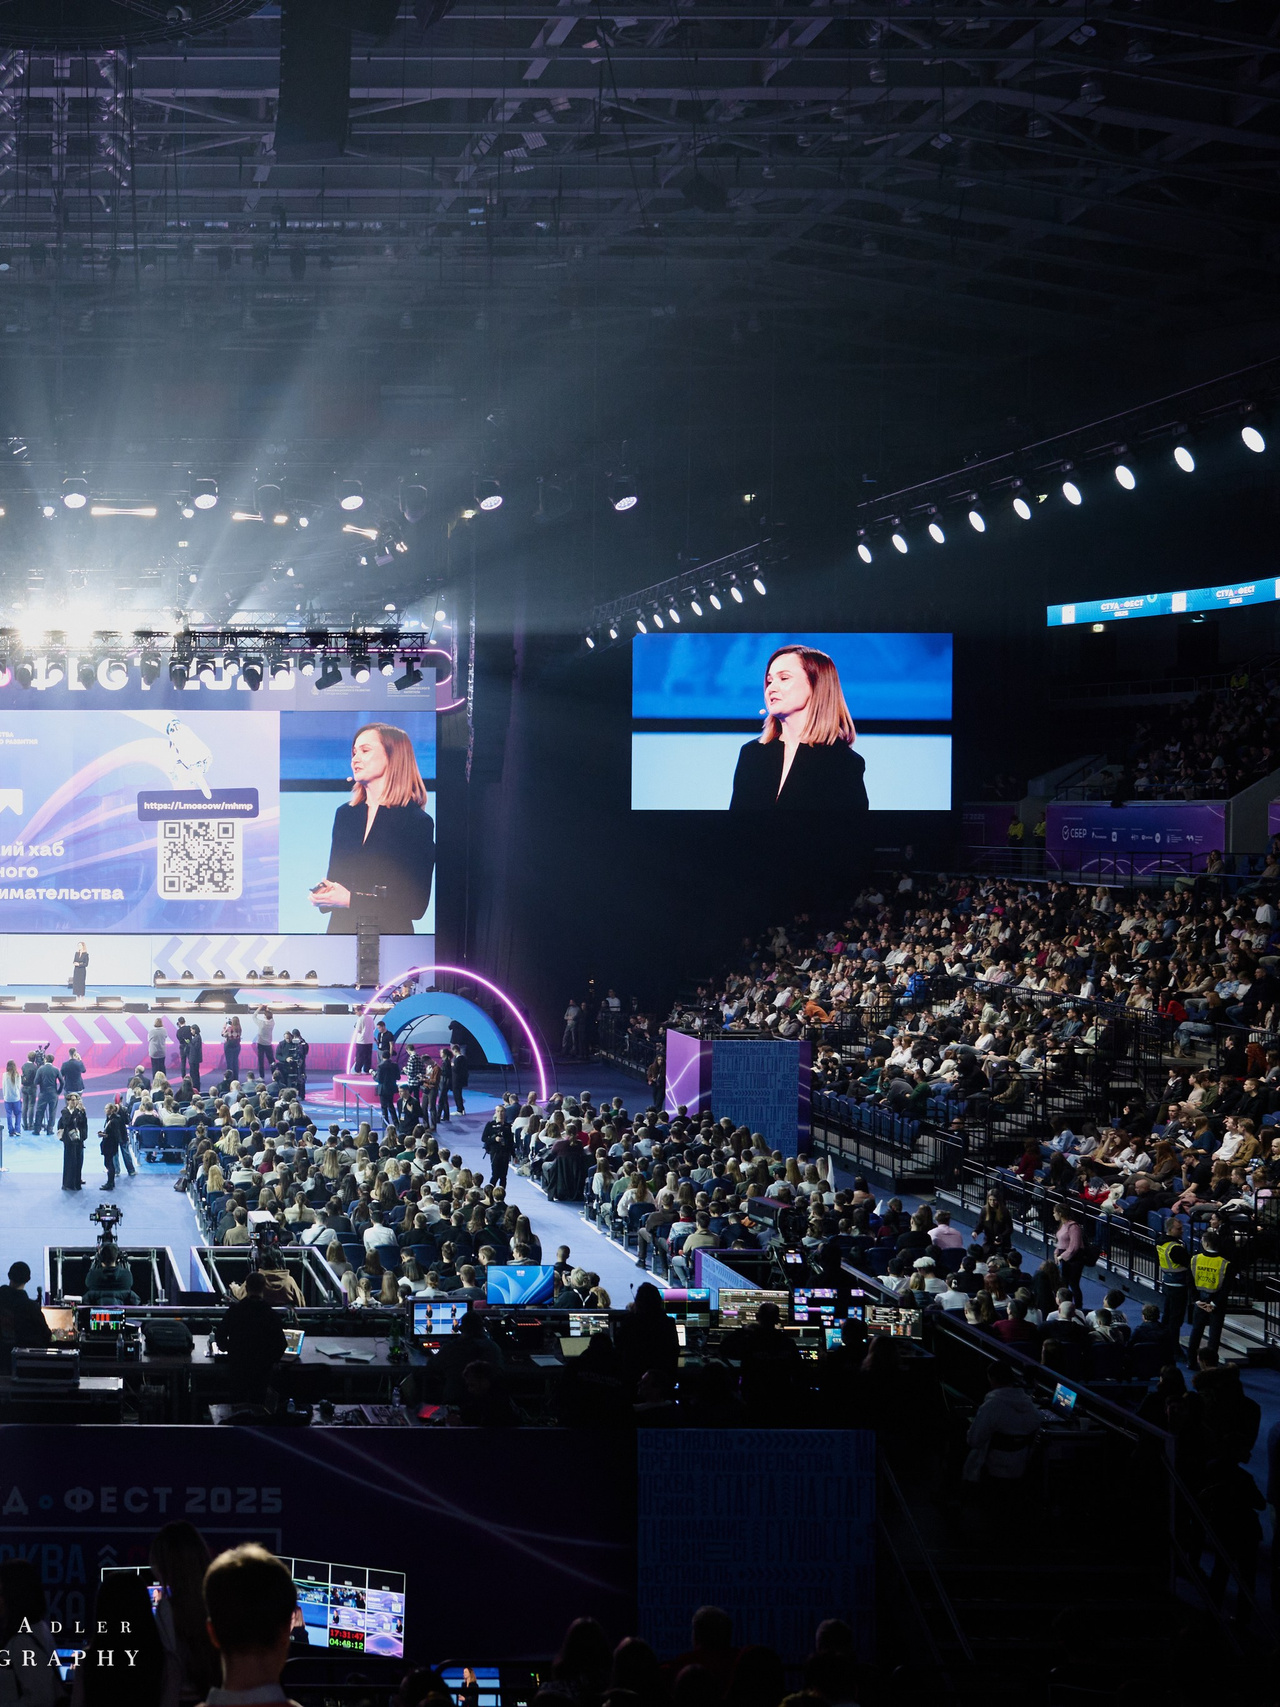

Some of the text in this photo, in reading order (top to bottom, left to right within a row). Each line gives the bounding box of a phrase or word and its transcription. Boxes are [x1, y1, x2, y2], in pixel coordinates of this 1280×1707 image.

[1070, 828, 1087, 838] СБЕР
[29, 840, 65, 857] хаб
[640, 1431, 734, 1450] ФЕСТИВАЛЬ
[639, 1452, 834, 1473] ПРЕДПРИНИМАТЕЛЬСТВА
[63, 1485, 174, 1514] ФЕСТ
[185, 1485, 283, 1514] 2025
[713, 1475, 777, 1516] СТАРТА
[794, 1476, 818, 1517] НА
[329, 1638, 364, 1650] 04:48:12
[330, 1629, 365, 1641] 17:31:47
